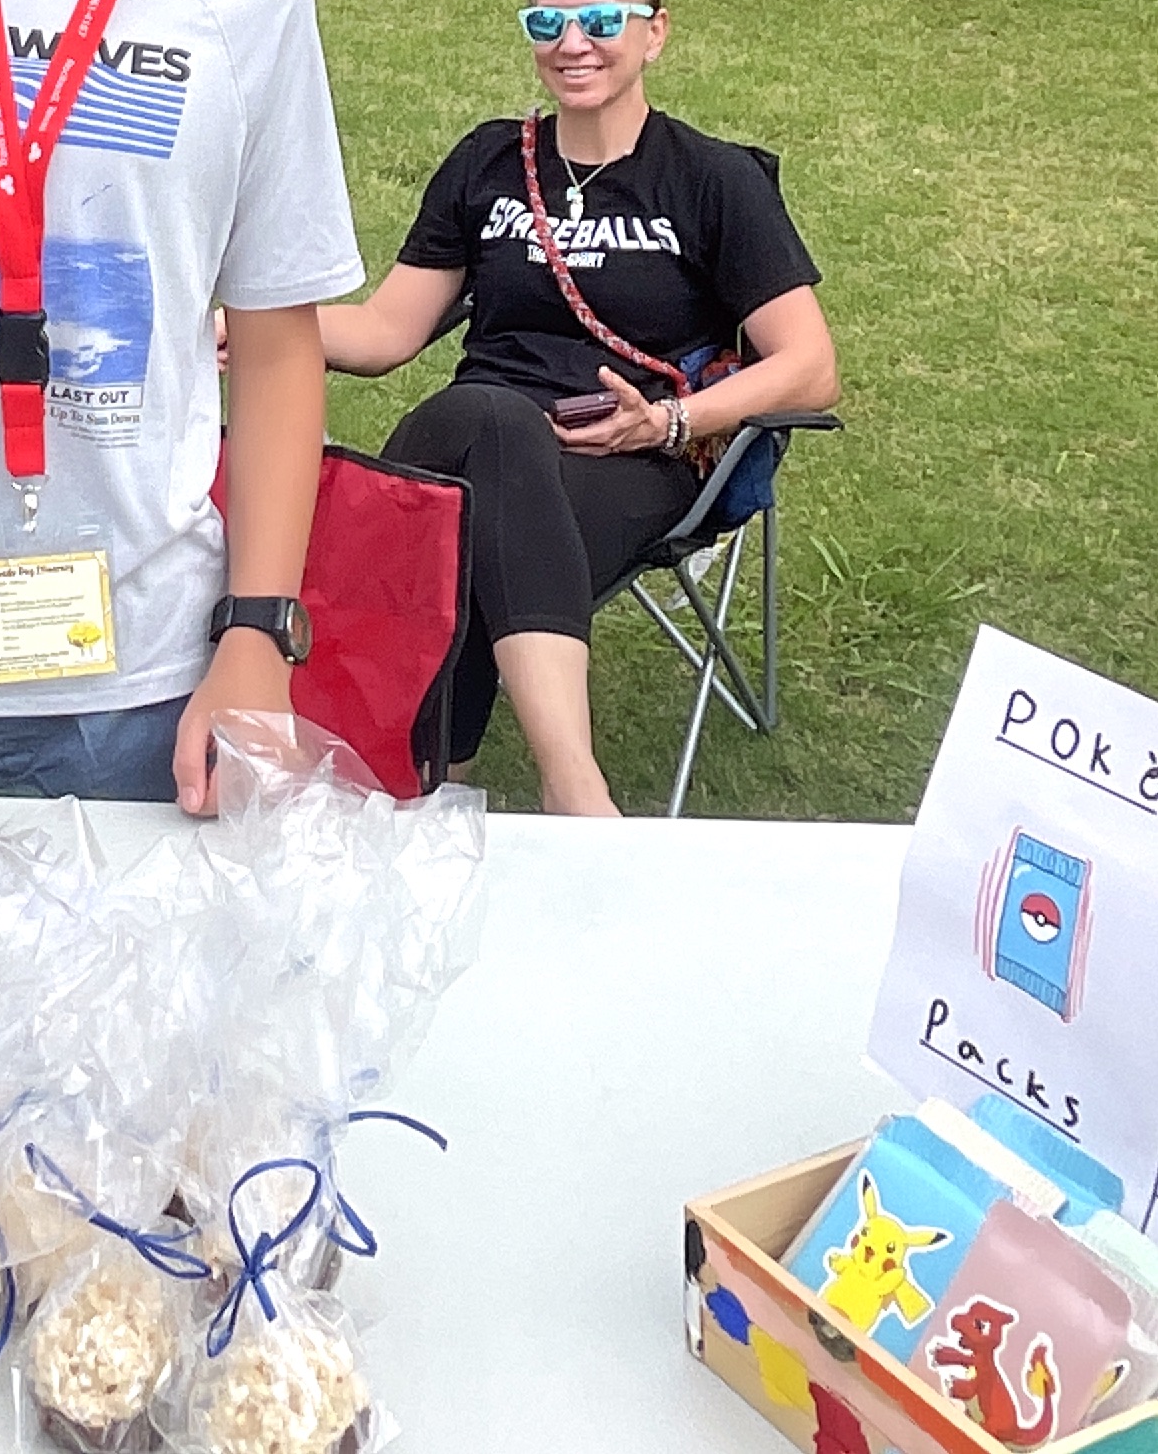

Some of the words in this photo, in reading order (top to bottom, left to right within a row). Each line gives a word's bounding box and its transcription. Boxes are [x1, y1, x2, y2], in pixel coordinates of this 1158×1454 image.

[8, 25, 192, 82] WVES
[50, 385, 95, 404] LAST
[98, 390, 130, 405] OUT
[50, 406, 68, 422] Up
[925, 997, 1081, 1128] Packs
